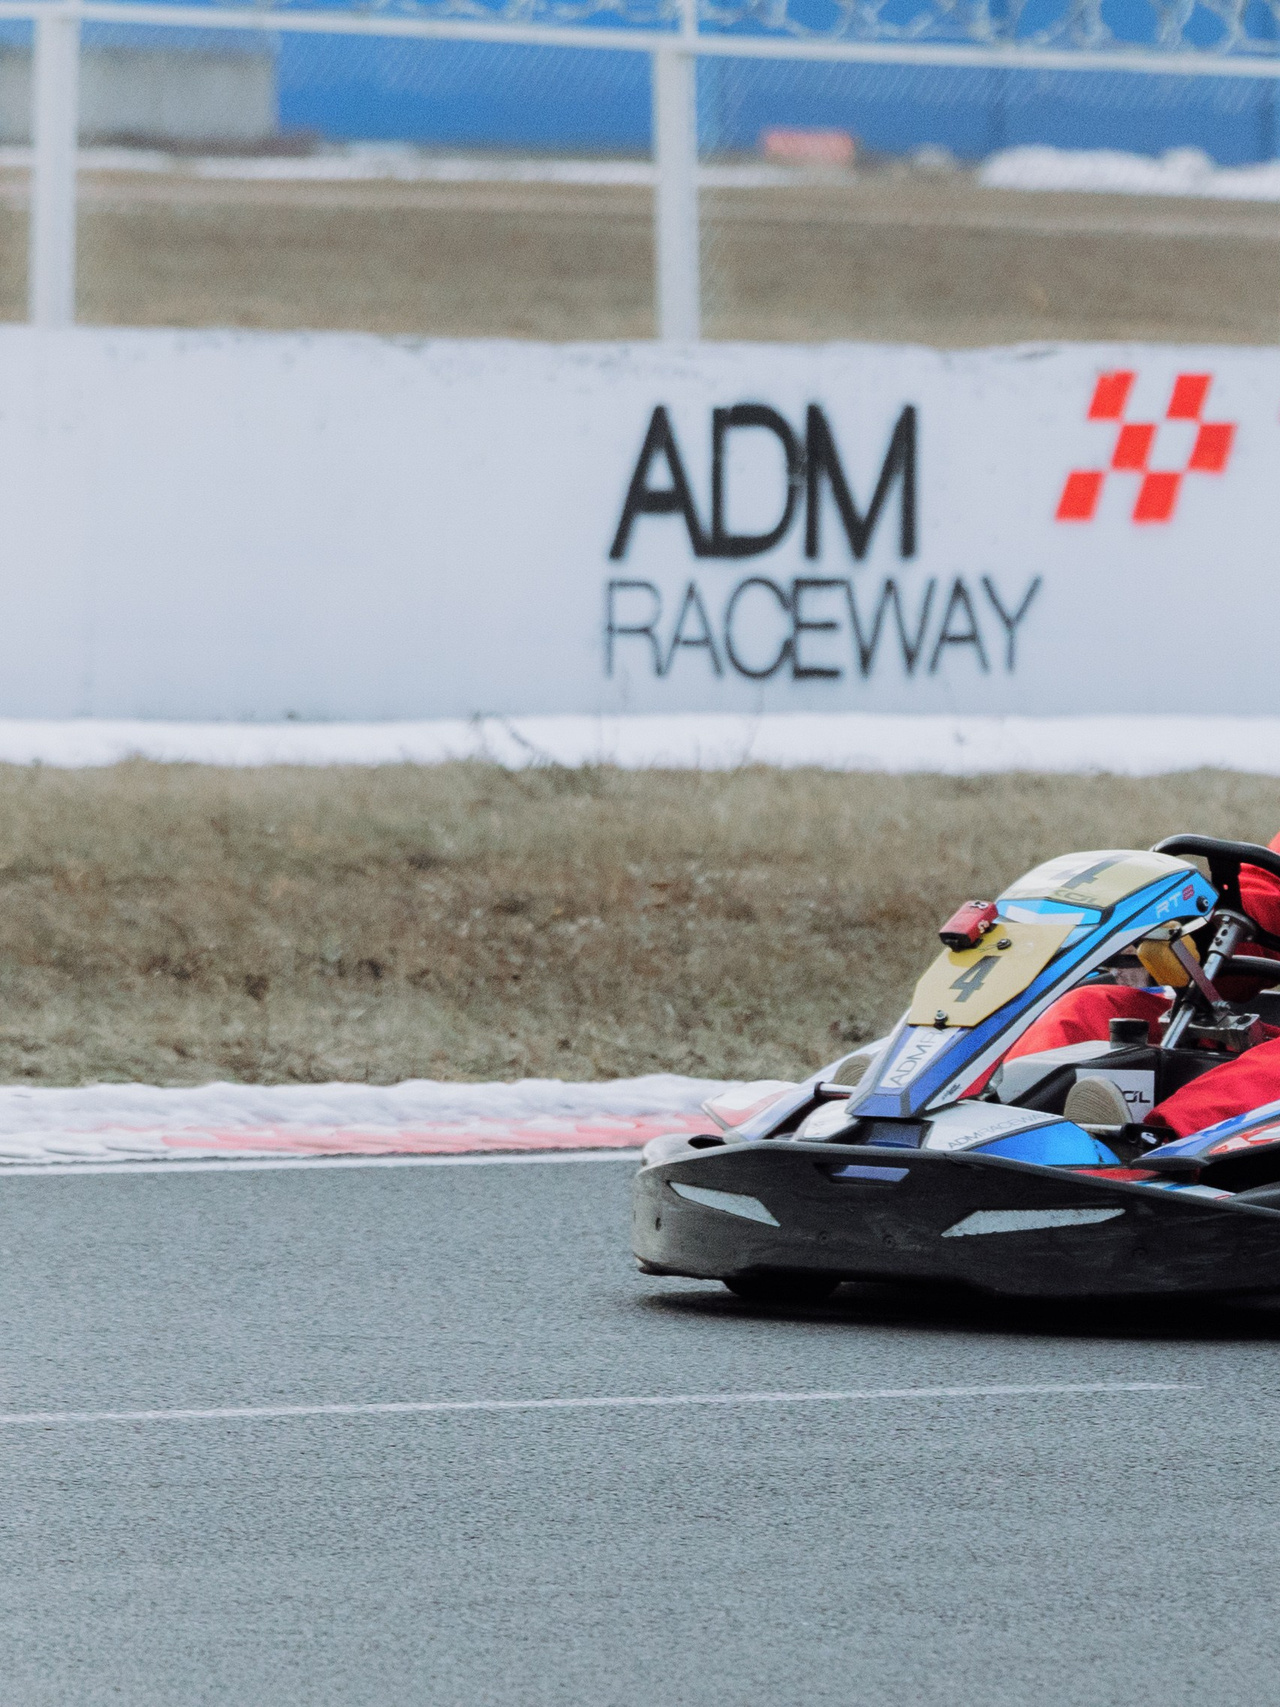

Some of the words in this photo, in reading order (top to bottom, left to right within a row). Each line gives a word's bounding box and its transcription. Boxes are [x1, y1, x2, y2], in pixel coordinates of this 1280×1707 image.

[608, 402, 919, 561] ADM
[604, 575, 1042, 680] RACEWAY
[949, 956, 1002, 1003] 4
